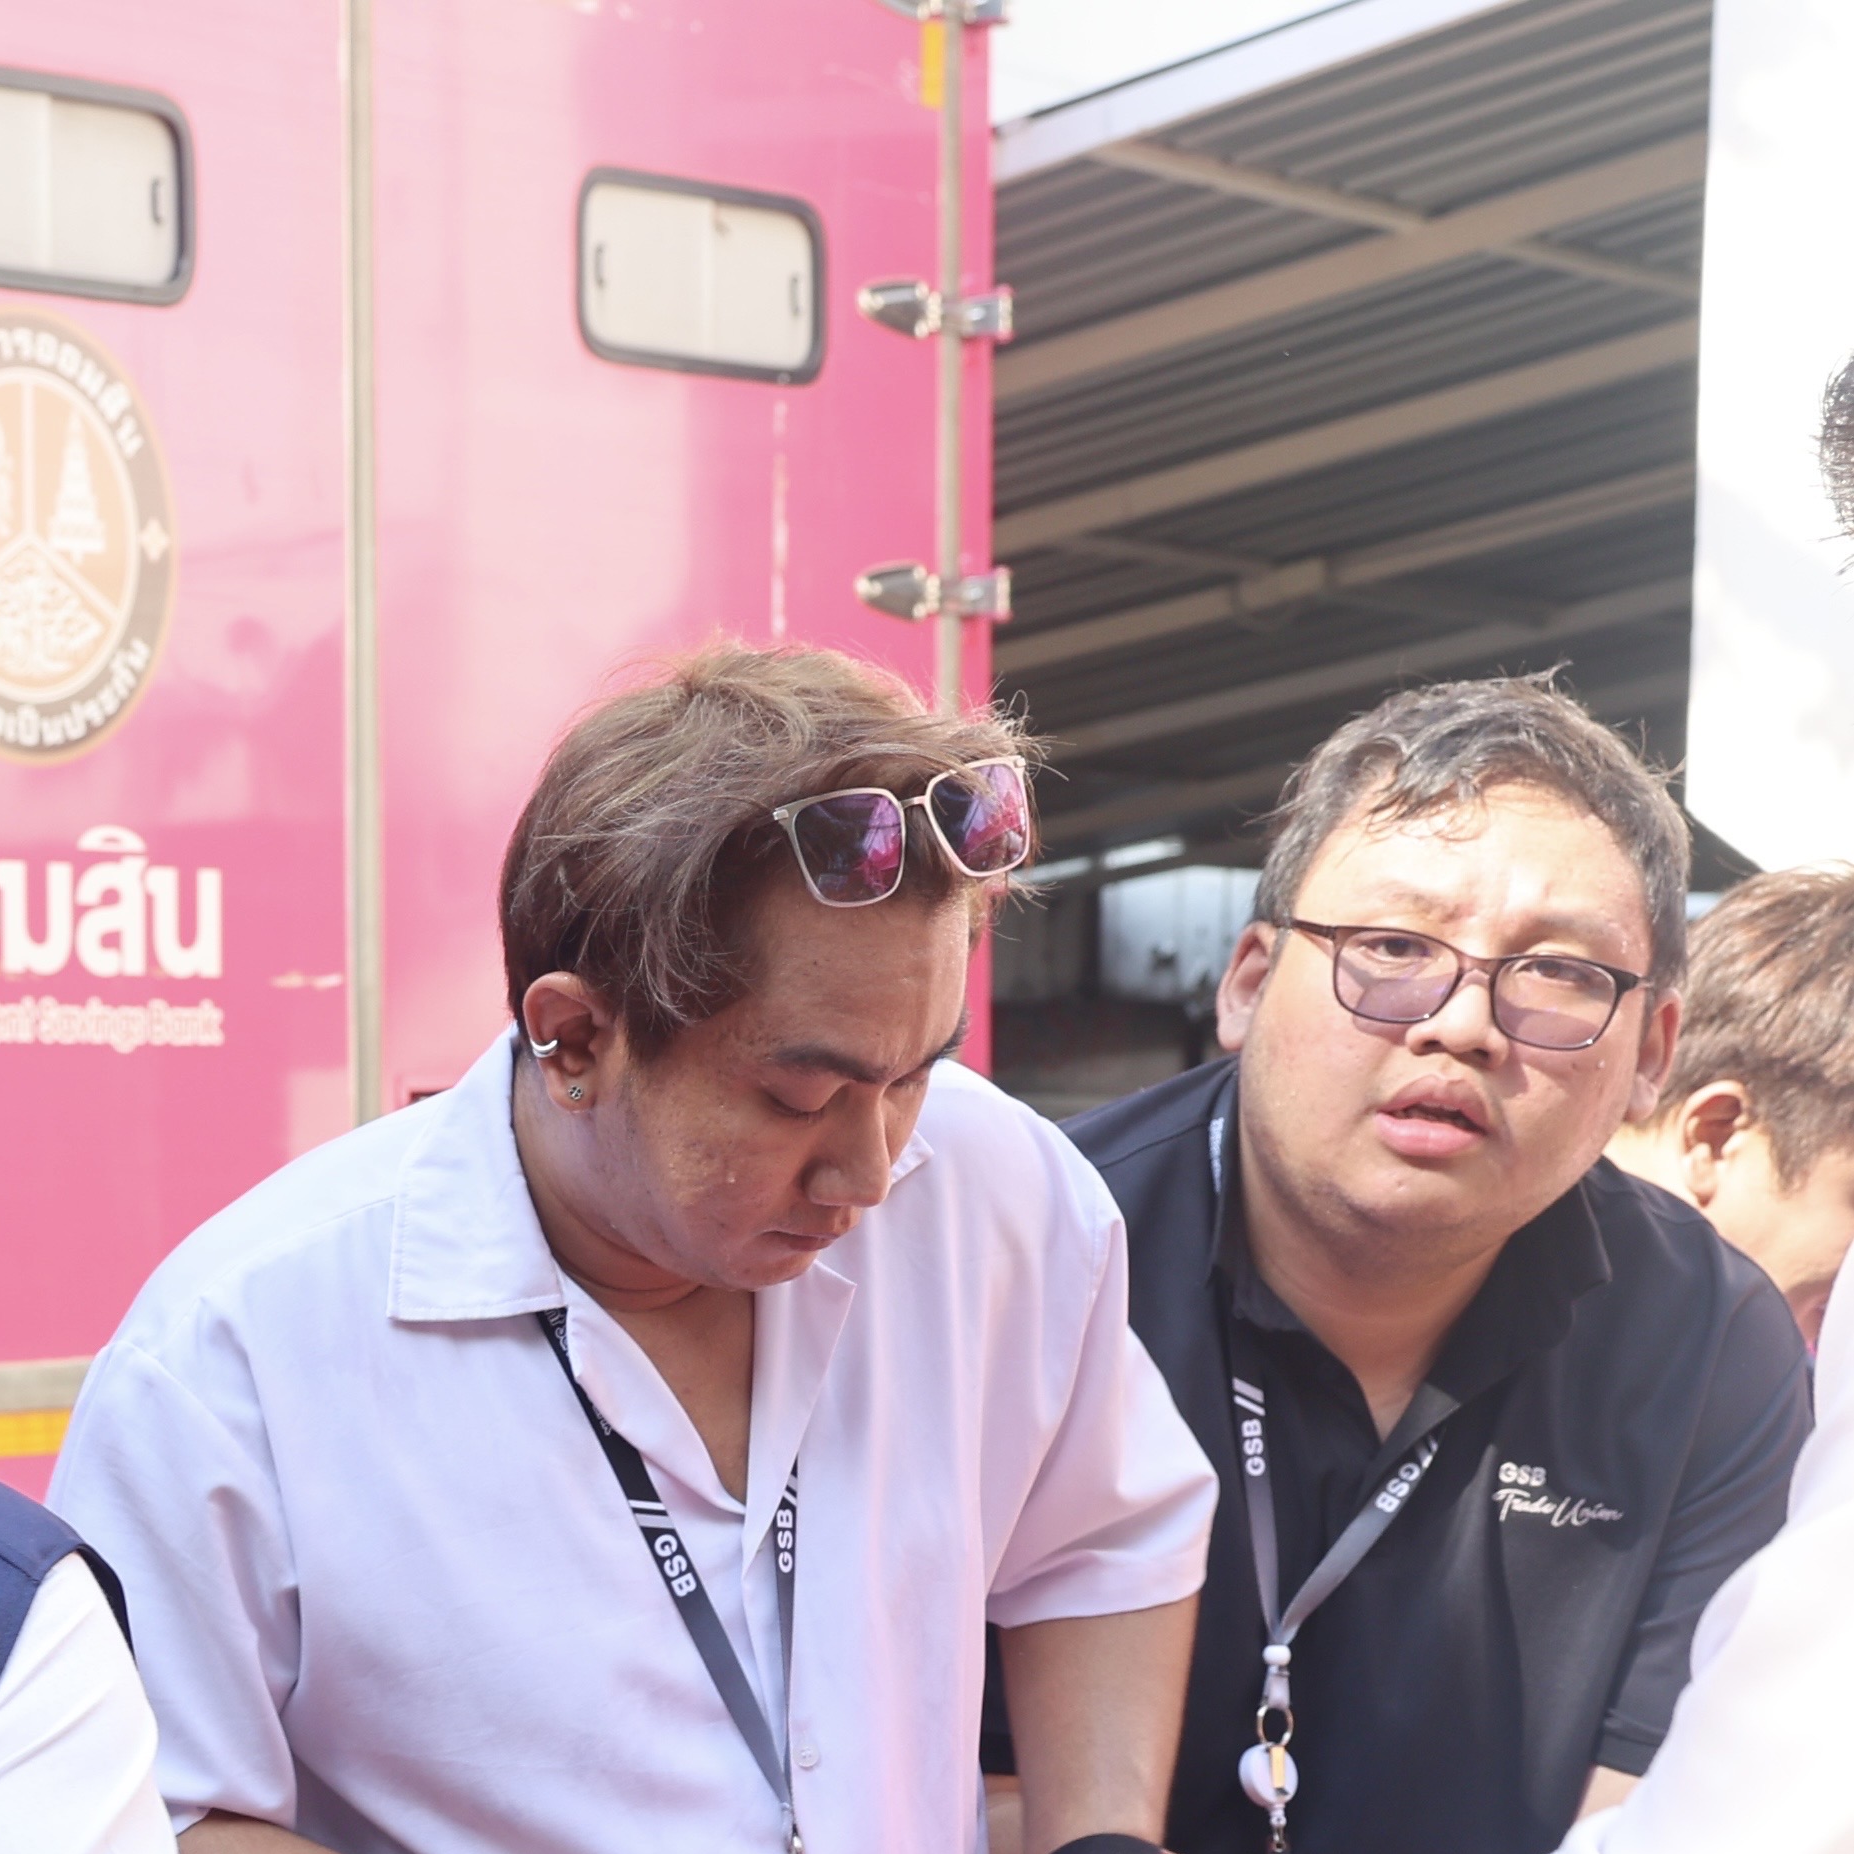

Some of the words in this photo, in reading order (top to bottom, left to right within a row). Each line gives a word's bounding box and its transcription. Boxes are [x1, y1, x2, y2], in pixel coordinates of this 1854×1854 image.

[37, 995, 147, 1054] Savings
[147, 998, 225, 1047] Bank
[1242, 1418, 1266, 1477] GSB
[1498, 1461, 1547, 1487] GSB
[1375, 1462, 1421, 1514] GSB
[654, 1533, 697, 1598] GSB
[776, 1508, 794, 1574] GSB
